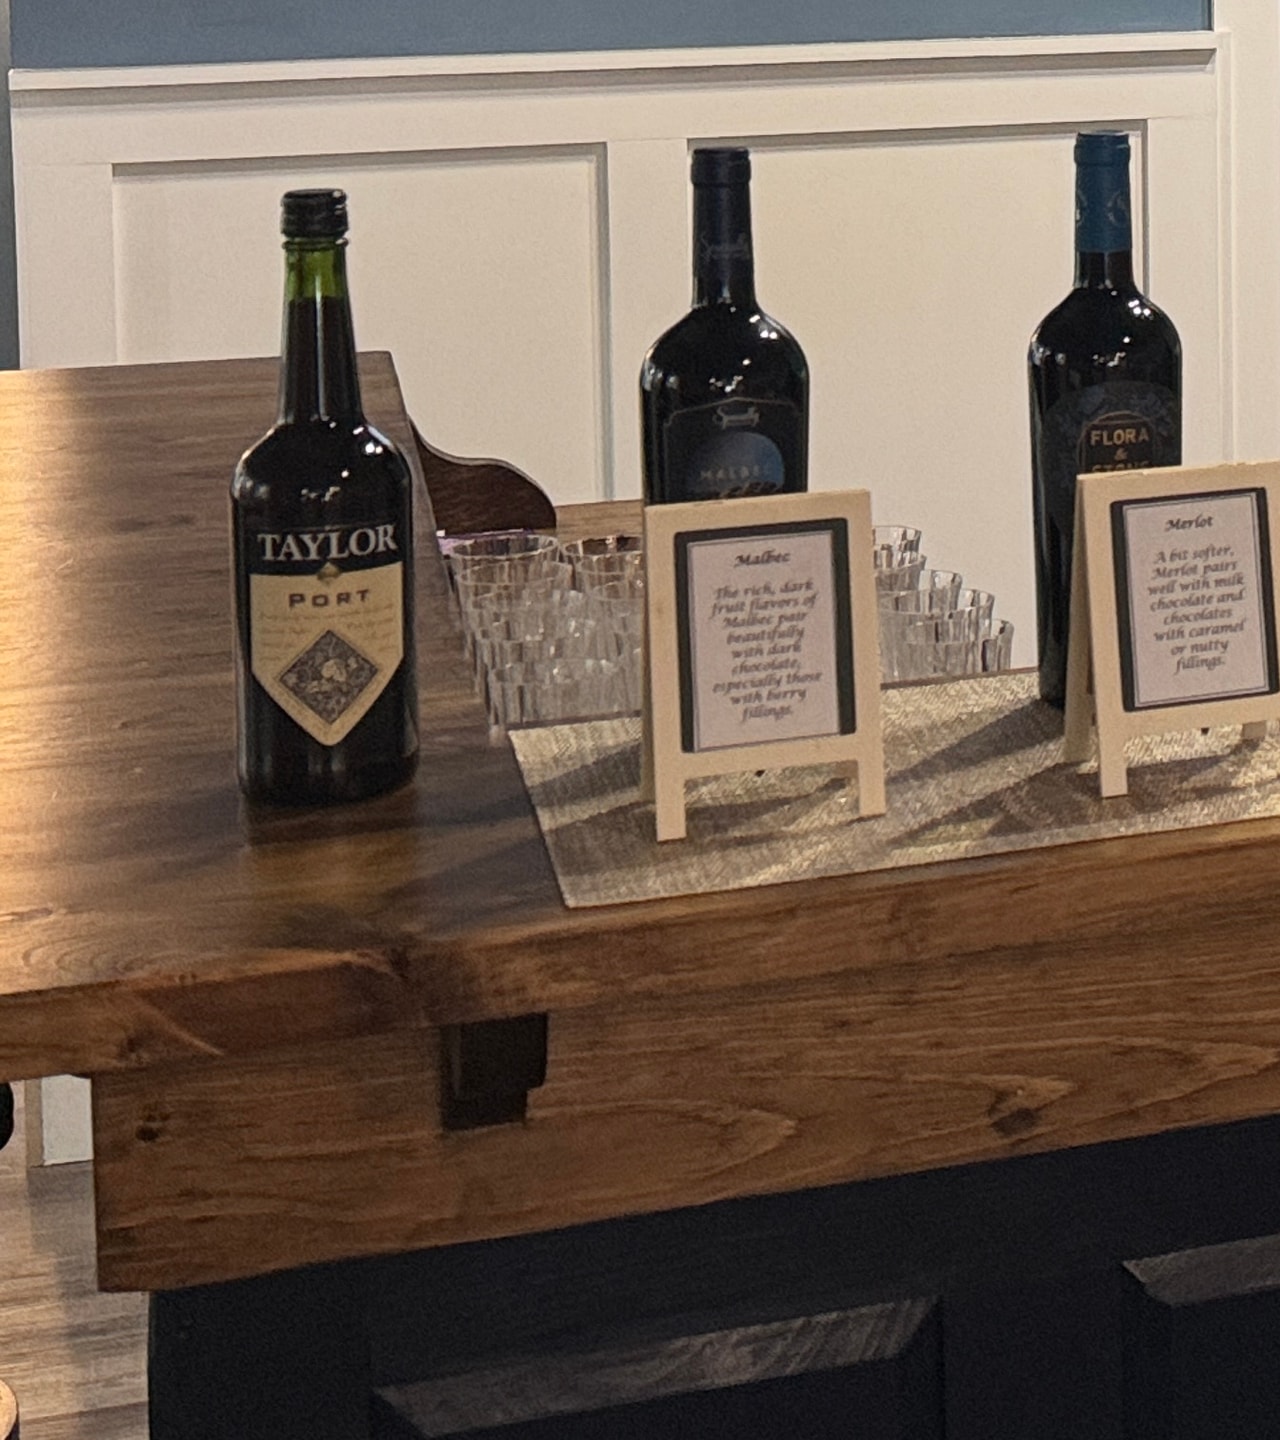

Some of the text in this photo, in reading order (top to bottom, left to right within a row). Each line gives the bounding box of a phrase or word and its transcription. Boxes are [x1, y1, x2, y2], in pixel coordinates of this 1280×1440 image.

[1091, 428, 1149, 446] FLORA
[1164, 514, 1214, 531] Merlot
[257, 524, 398, 561] TAYLOR
[734, 549, 791, 567] Malbec
[1153, 551, 1166, 564] A
[1169, 548, 1189, 561] bit
[1152, 561, 1238, 580] Merlot pairs
[714, 579, 814, 600] The rich, dark
[1147, 573, 1244, 595] well with milk
[289, 589, 370, 607] PORT
[710, 592, 819, 619] fruit flavors of
[1150, 588, 1246, 612] chocolate and
[723, 611, 808, 628] Malbec pair
[1163, 608, 1233, 625] chocolates
[727, 626, 805, 645] beautifully
[1153, 618, 1247, 641] with caramel
[731, 641, 802, 659] with dark
[1171, 640, 1229, 656] or nutty
[712, 672, 823, 696] especially those
[730, 687, 807, 705] with berry
